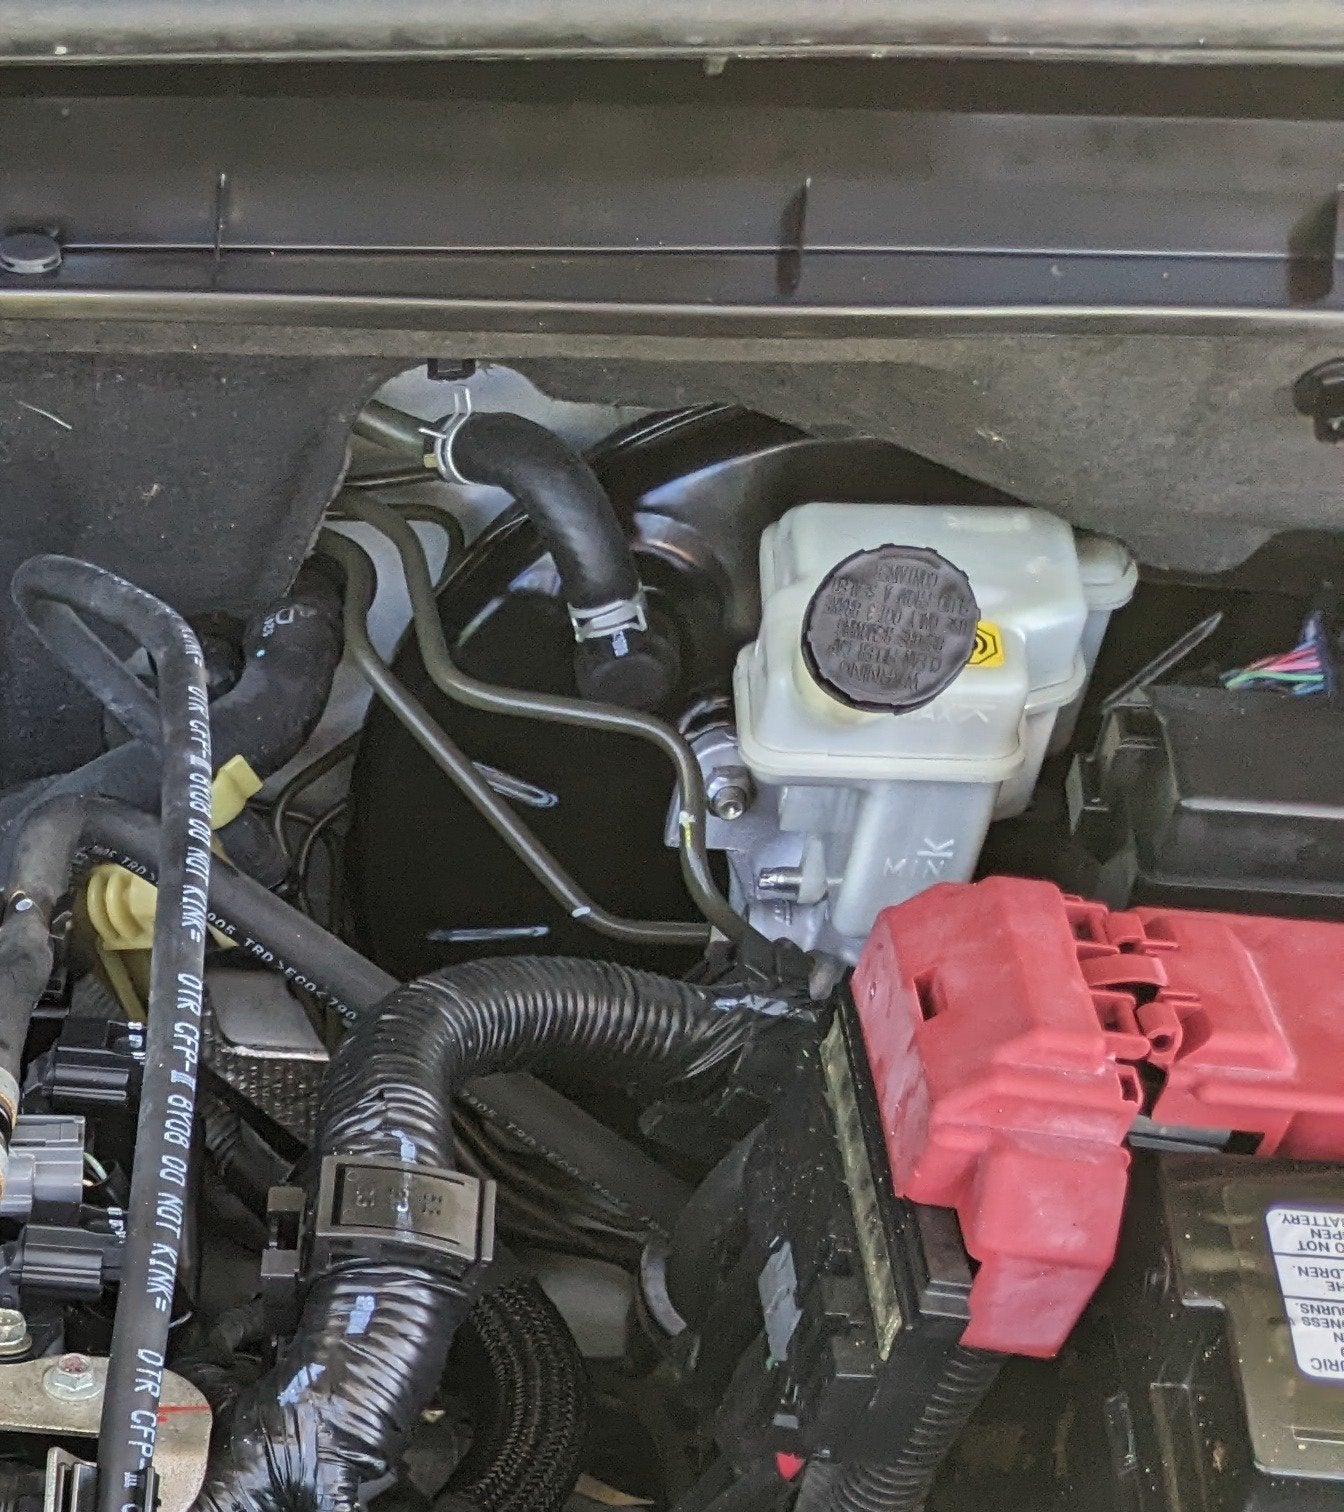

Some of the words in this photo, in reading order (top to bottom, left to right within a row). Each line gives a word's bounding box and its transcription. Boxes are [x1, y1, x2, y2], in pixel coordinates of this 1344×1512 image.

[186, 847, 209, 884] NOT
[160, 1155, 187, 1186] DO
[156, 1192, 185, 1239] NOT
[1298, 1241, 1330, 1253] NOT
[146, 1243, 179, 1312] KINK=
